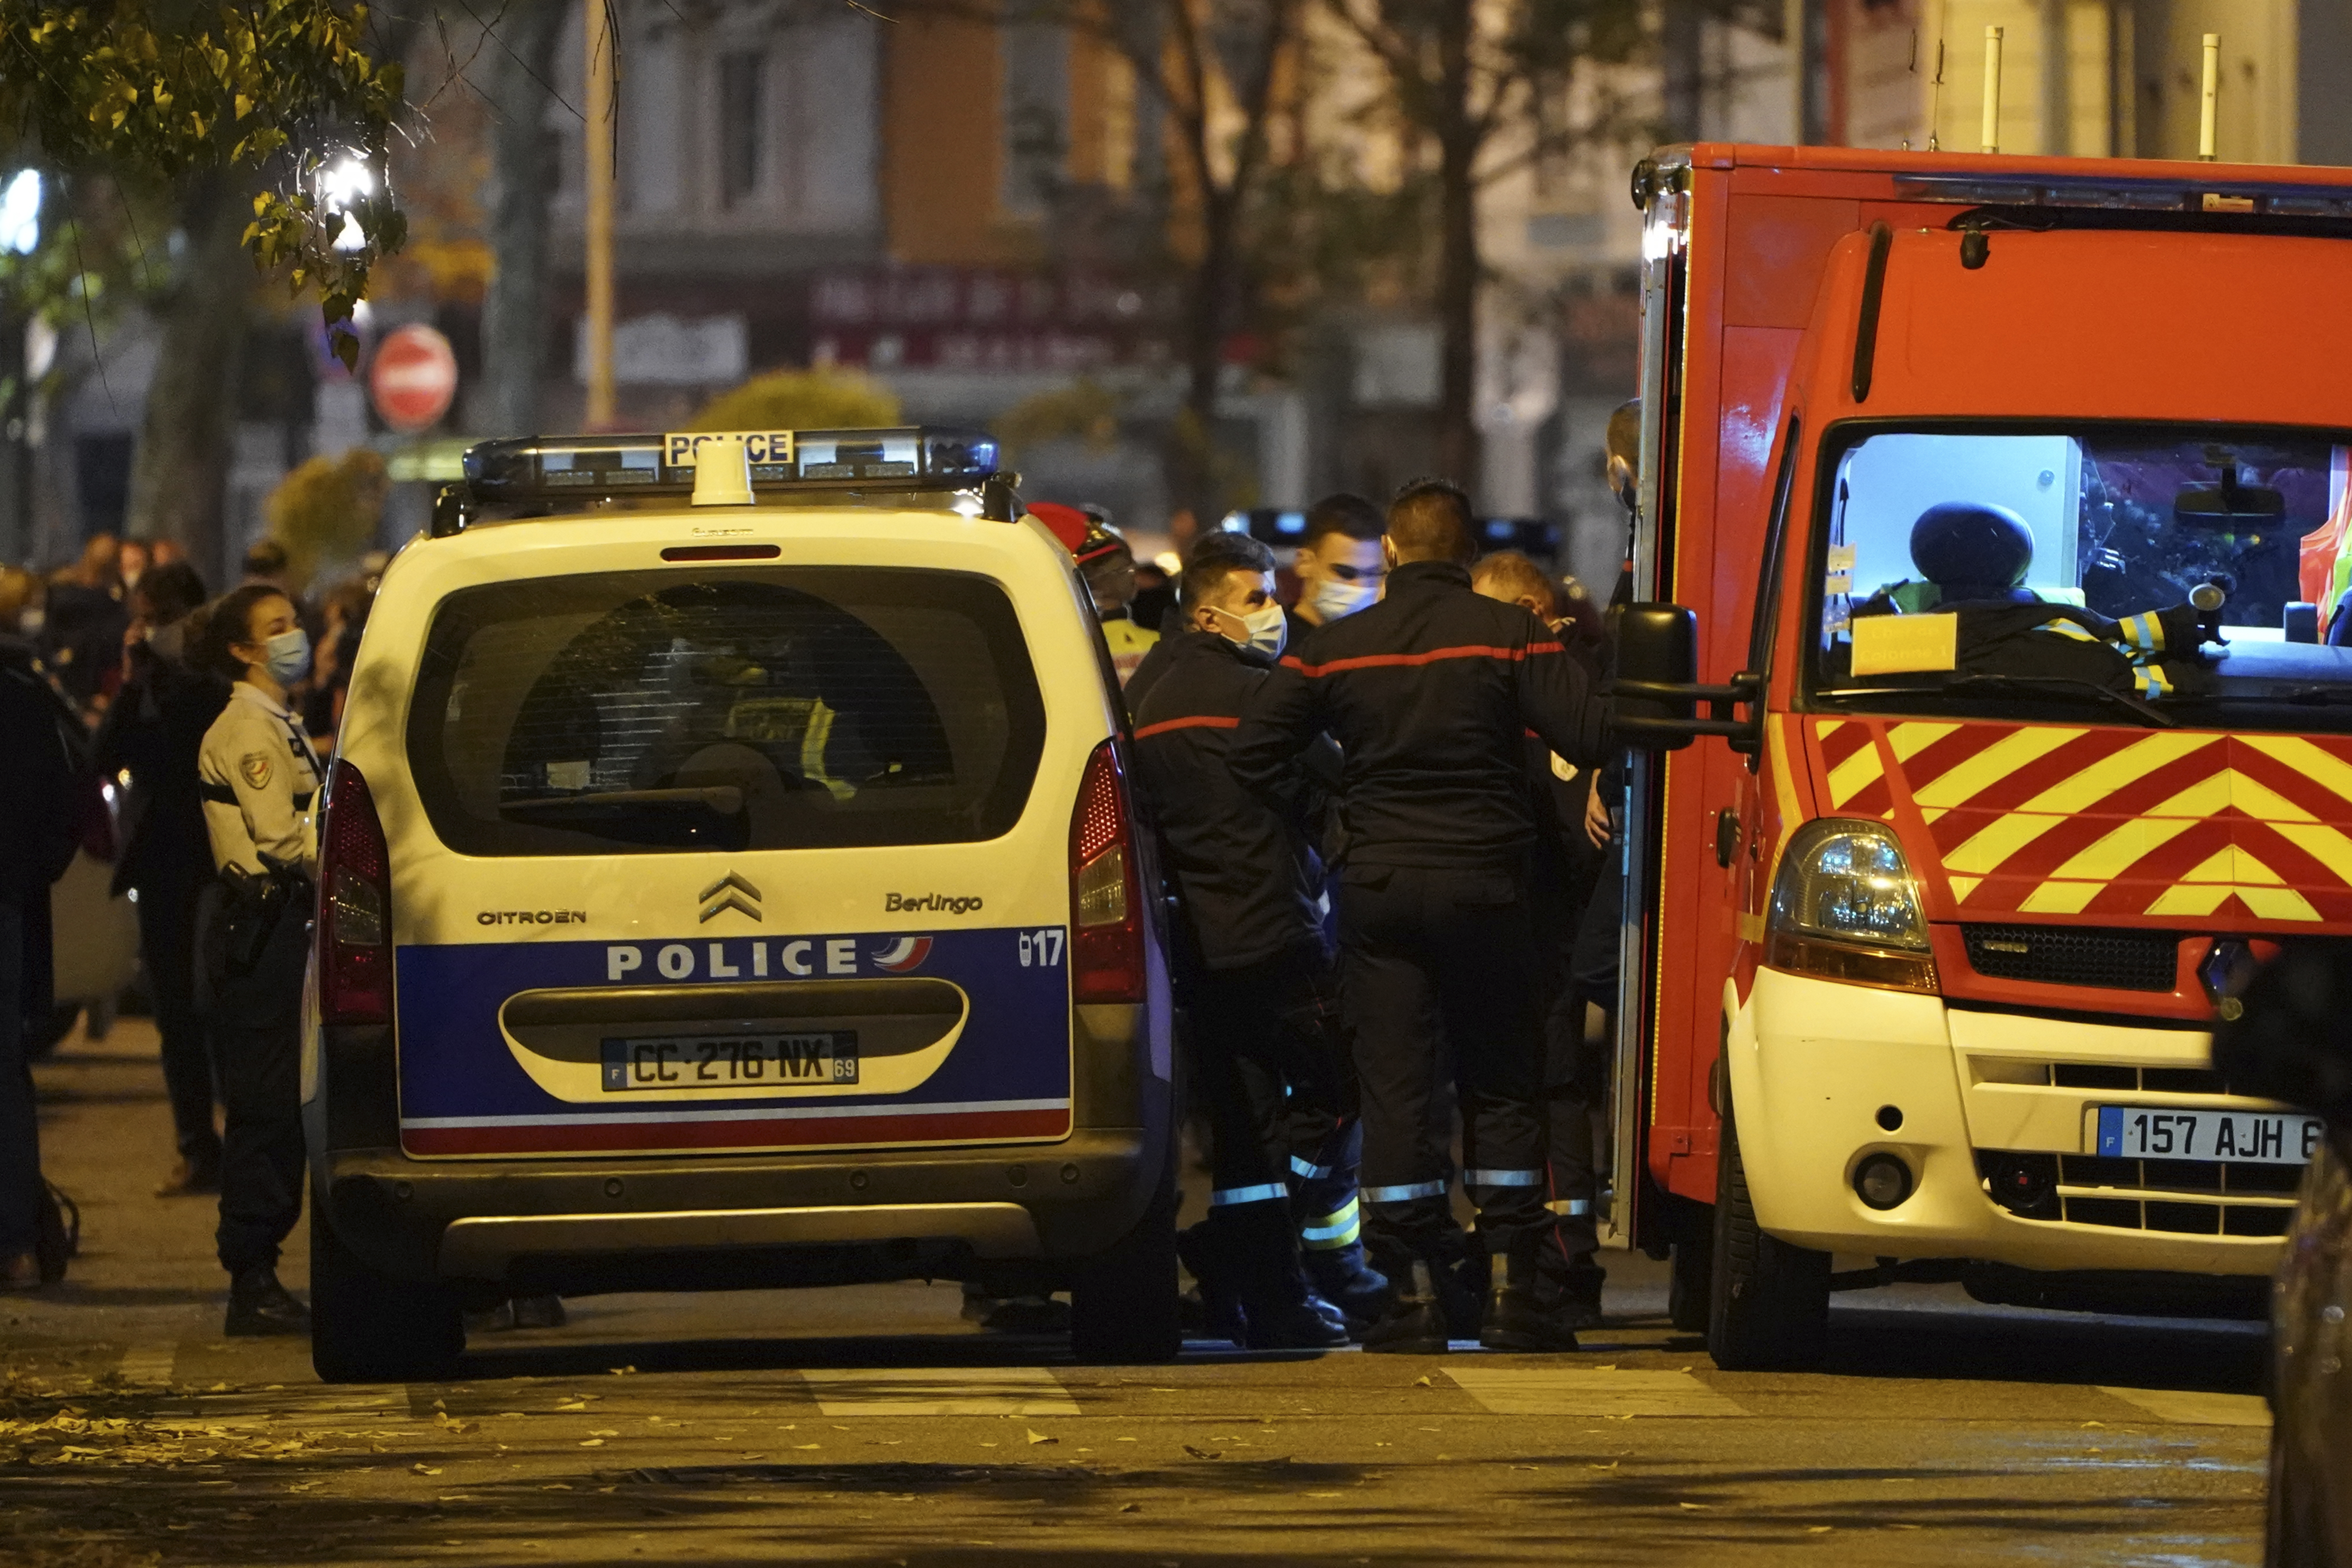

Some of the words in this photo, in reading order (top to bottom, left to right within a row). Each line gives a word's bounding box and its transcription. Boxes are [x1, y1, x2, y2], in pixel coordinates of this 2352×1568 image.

[671, 434, 788, 465] POCE
[477, 908, 586, 925] CITROËN
[885, 892, 983, 915] Berlingo
[607, 940, 857, 980] POLICE
[1033, 929, 1063, 966] 17
[611, 1069, 620, 1080] F
[834, 1059, 855, 1078] 69
[2106, 1136, 2115, 1148] F
[2134, 1114, 2197, 1154] 157
[2215, 1117, 2283, 1158] AJH
